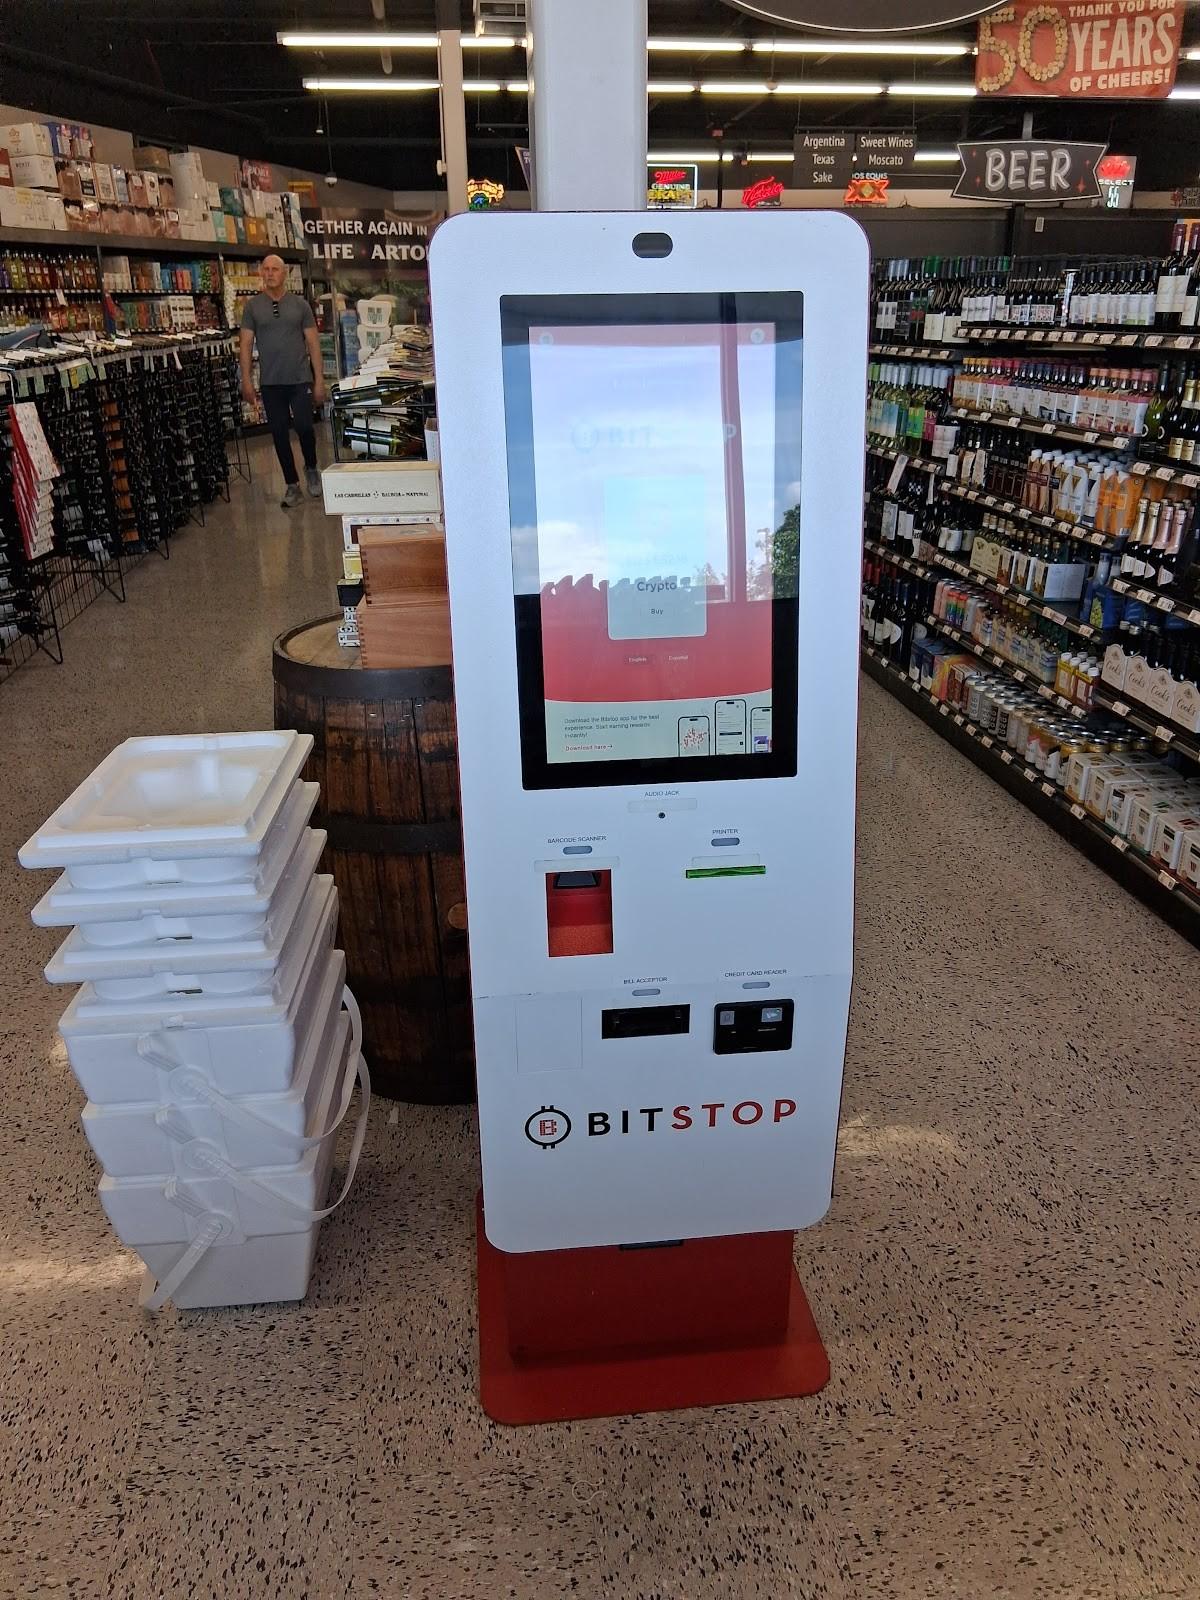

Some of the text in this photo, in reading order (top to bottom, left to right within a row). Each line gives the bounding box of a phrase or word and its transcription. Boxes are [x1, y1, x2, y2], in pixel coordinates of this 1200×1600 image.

[1069, 0, 1176, 18] THANK YOU FOR
[978, 4, 1069, 92] 50
[1070, 13, 1176, 73] YEARS
[1069, 68, 1172, 92] OF CHEERS!
[803, 135, 846, 149] Argentina
[860, 136, 914, 148] Sweet Wines
[812, 154, 835, 165] Texas
[868, 154, 904, 166] Moscato
[812, 171, 833, 183] Sake
[984, 148, 1072, 193] BEER
[1106, 185, 1120, 208] 55
[368, 221, 413, 236] AGAIN
[416, 225, 428, 236] IN
[312, 243, 355, 260] LIFE
[636, 581, 678, 593] Crypto
[587, 1098, 798, 1137] BITSTOP
